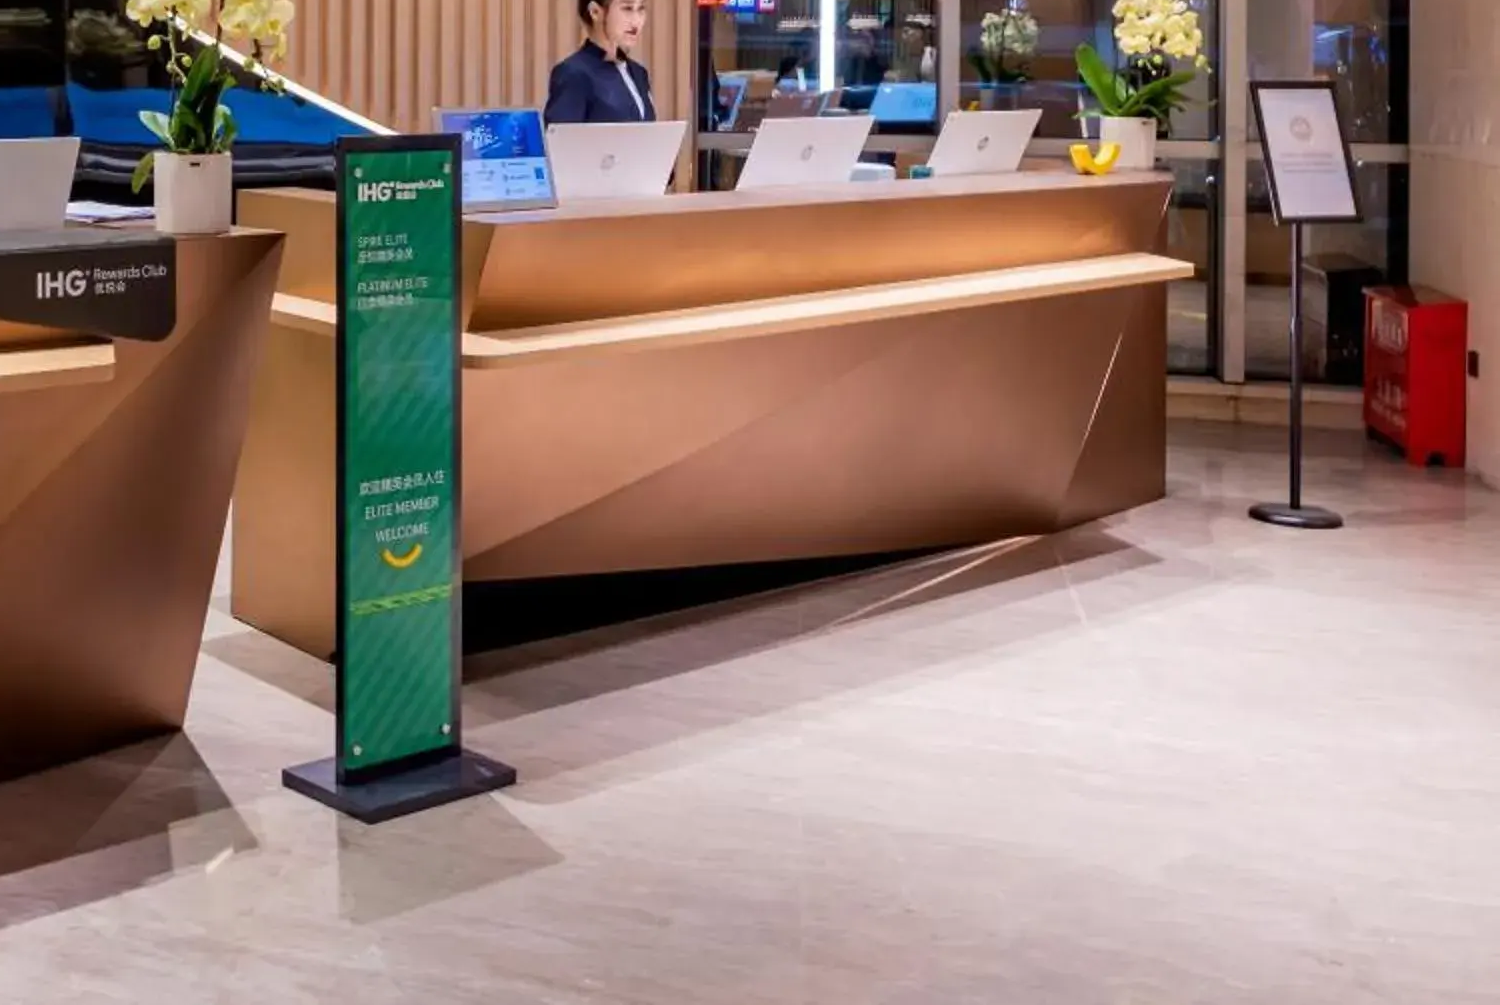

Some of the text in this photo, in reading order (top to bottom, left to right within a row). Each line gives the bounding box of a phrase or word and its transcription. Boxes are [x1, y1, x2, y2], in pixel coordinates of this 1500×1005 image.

[385, 233, 408, 246] ELITE
[36, 265, 167, 299] IHG Rewards Club
[357, 276, 428, 293] PLATINUM ELITE
[365, 496, 439, 520] ELITE MEMBER
[375, 522, 429, 543] WELCOME
